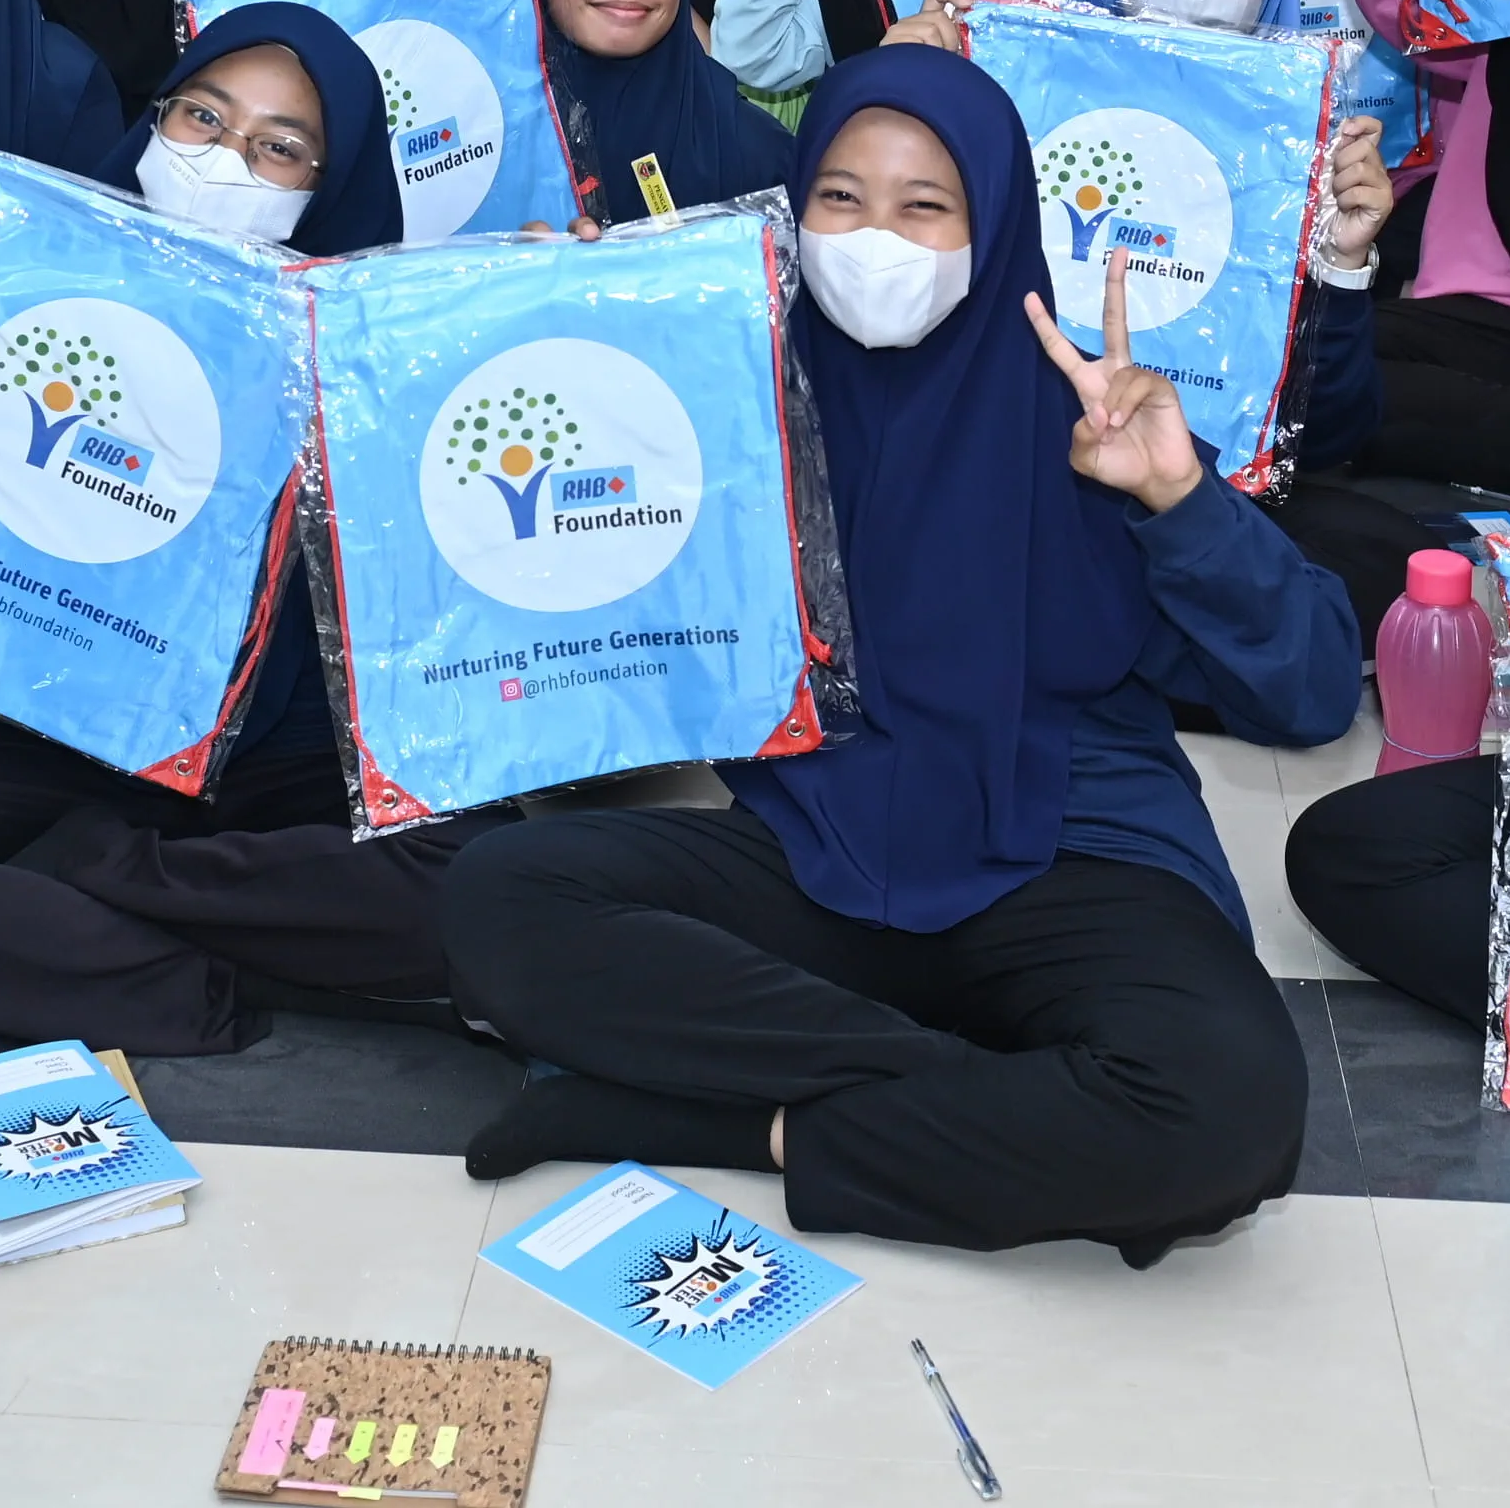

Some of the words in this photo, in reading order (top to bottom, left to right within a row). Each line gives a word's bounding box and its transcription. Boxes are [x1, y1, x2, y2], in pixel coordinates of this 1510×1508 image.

[408, 130, 439, 157] RHB
[404, 141, 494, 185] Foundation
[1115, 225, 1152, 247] RHB
[1102, 250, 1205, 284] Fundation
[80, 436, 126, 467] RHB
[61, 460, 178, 524] Foundation
[562, 476, 606, 502] RHB
[554, 504, 682, 535] Foundation
[57, 588, 169, 655] Generations
[423, 649, 527, 685] Nurturing
[532, 639, 603, 662] Future
[609, 625, 739, 651] Generations
[523, 659, 668, 700] @rhbfoundation
